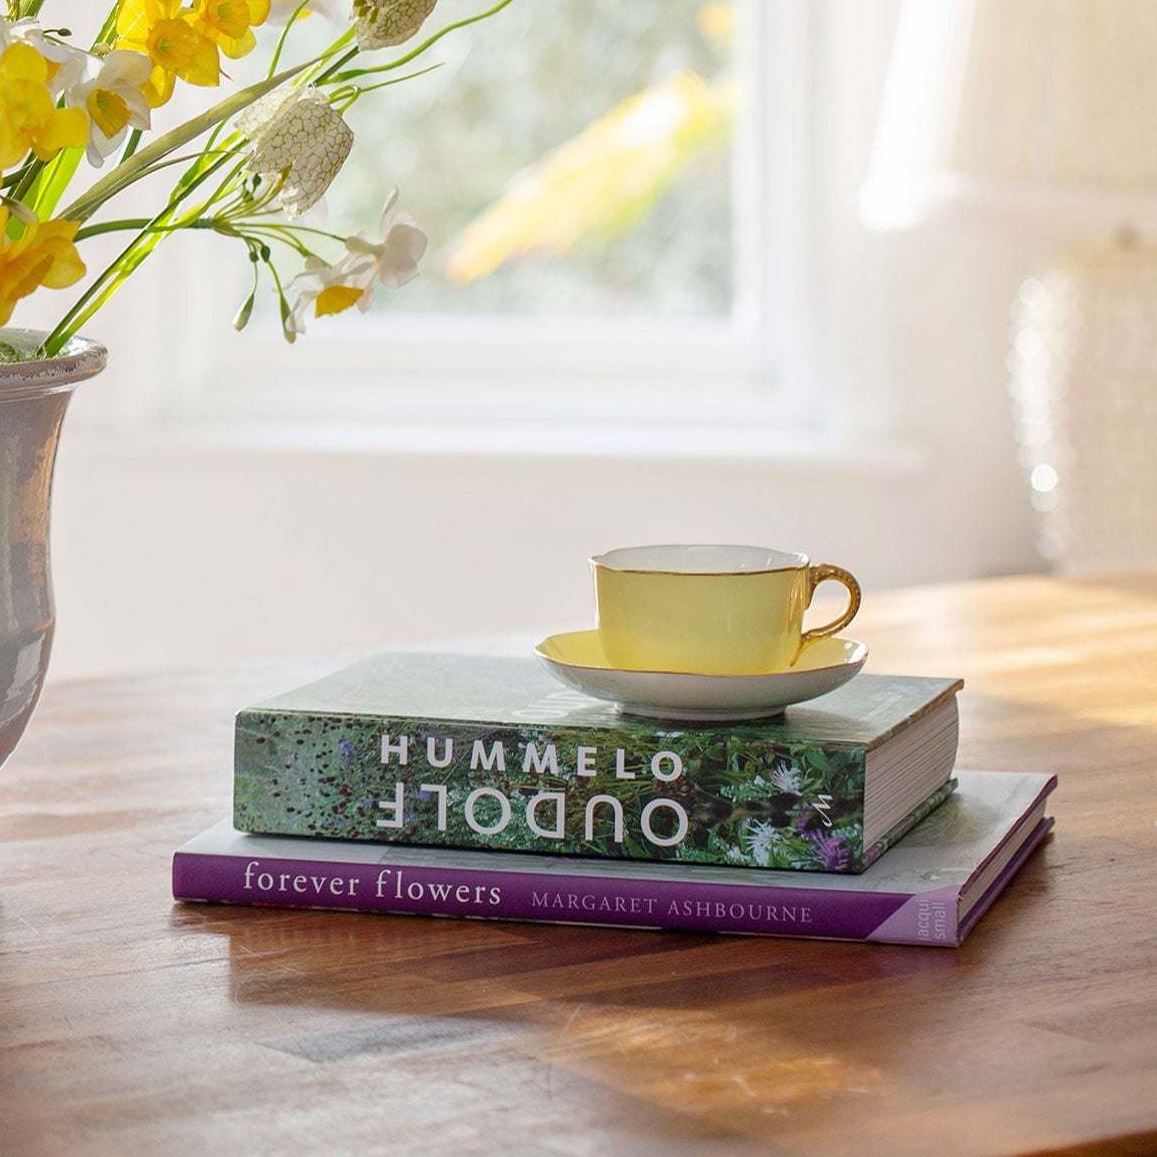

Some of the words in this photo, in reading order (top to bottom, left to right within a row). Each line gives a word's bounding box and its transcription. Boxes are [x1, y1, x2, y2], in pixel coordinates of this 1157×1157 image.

[380, 734, 683, 782] HUMMELO
[376, 782, 689, 847] OUDOLF
[244, 861, 360, 896] forever
[375, 869, 501, 905] flowers
[531, 892, 658, 915] MARGARET
[667, 900, 812, 923] ASHBOURNE
[915, 898, 932, 942] jacqui
[935, 902, 947, 941] small
